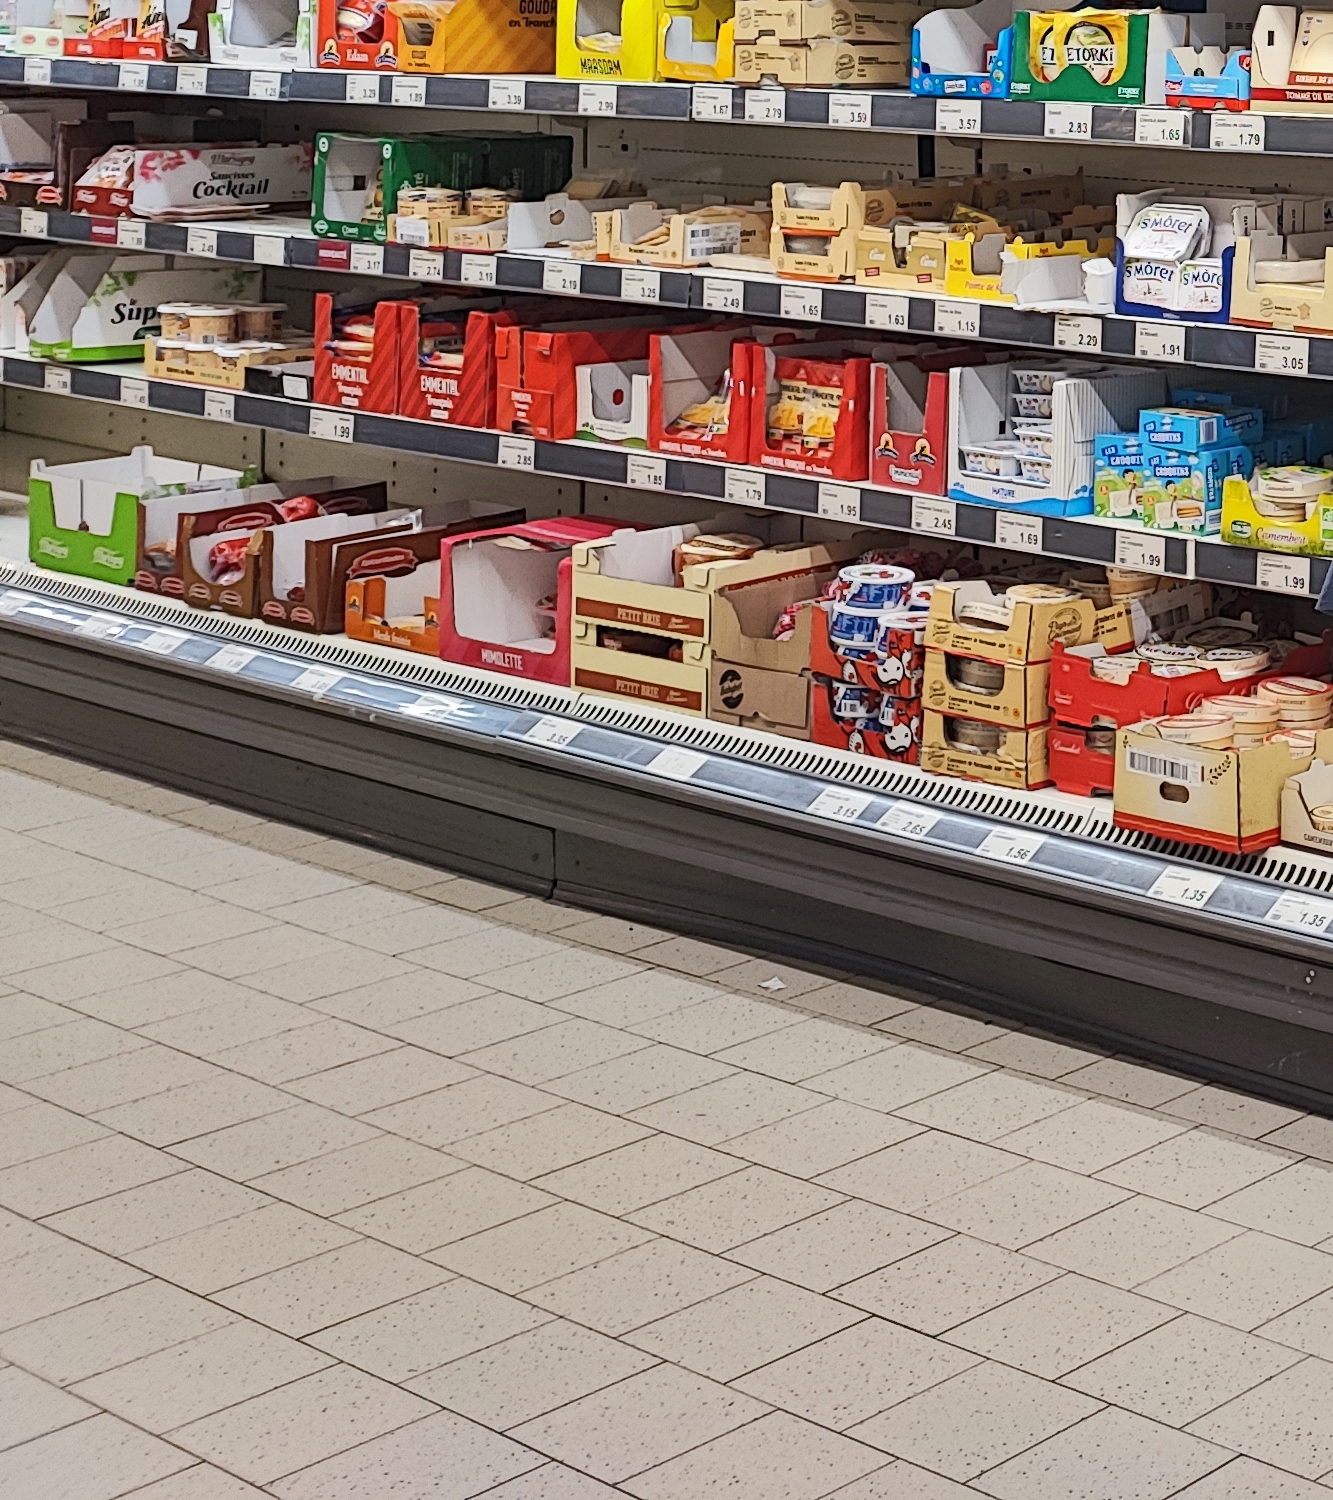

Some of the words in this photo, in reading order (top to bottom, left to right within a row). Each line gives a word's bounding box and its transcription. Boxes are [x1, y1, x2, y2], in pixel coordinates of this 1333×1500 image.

[1067, 47, 1115, 63] ETORKI
[766, 108, 782, 118] 2.79
[958, 119, 977, 130] 3.57
[1161, 129, 1180, 140] 1.65
[1239, 133, 1261, 146] 1.79
[193, 179, 269, 199] Cocktail
[640, 288, 656, 298] 3.25
[723, 297, 739, 308] 2.49
[802, 305, 818, 316] 1.65
[888, 314, 905, 325] 1.63
[957, 322, 976, 333] 1.15
[1078, 334, 1097, 346] 2.29
[1161, 344, 1180, 355] 1.91
[1283, 357, 1304, 369] 3.05
[333, 426, 350, 437] 1.99
[840, 505, 857, 516] 1.95
[934, 518, 952, 529] 2.45
[1020, 532, 1038, 544] 1.69
[1256, 528, 1307, 544] Camembert
[1141, 553, 1160, 565] 1.99
[1285, 575, 1305, 588] 1.99
[617, 607, 639, 623] PETIT
[641, 611, 661, 626] BRIE
[833, 804, 857, 818] 3.15
[900, 821, 926, 835] 2.65
[1180, 887, 1204, 900] 1.35
[1301, 912, 1326, 927] 1.35
